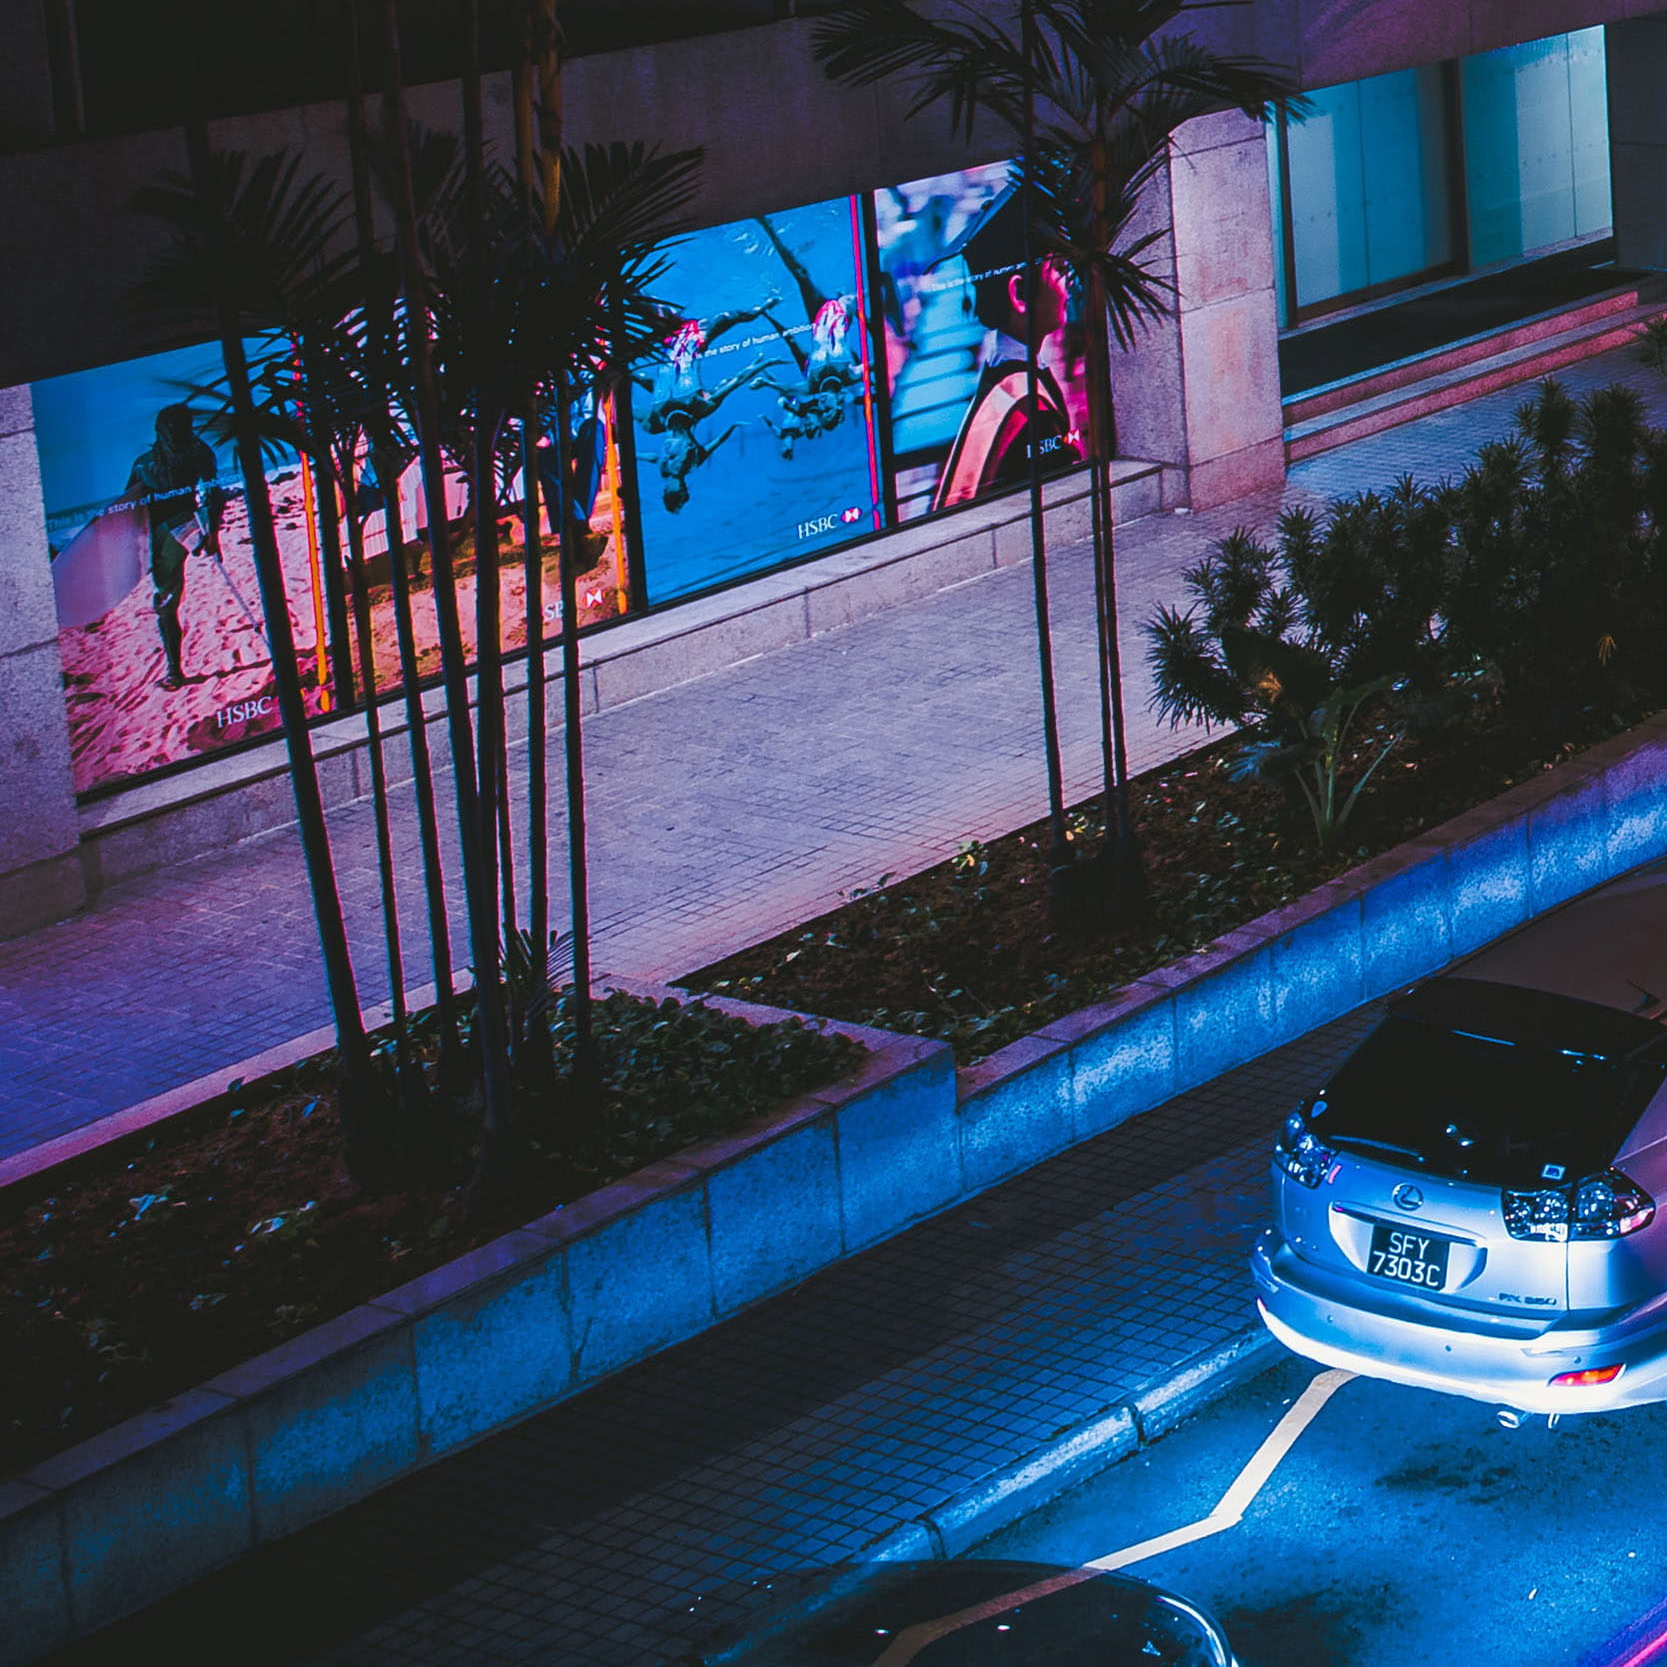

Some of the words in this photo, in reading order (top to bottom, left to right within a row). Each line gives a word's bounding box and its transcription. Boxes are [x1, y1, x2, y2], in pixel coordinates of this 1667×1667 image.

[719, 342, 740, 355] story
[742, 338, 751, 348] of
[752, 332, 779, 345] human
[107, 500, 137, 516] story
[139, 494, 151, 507] of
[153, 485, 192, 502] human
[797, 513, 838, 540] HSBC
[216, 695, 272, 728] HSBC
[1388, 1231, 1430, 1259] SFY
[1373, 1250, 1441, 1287] 7303C
